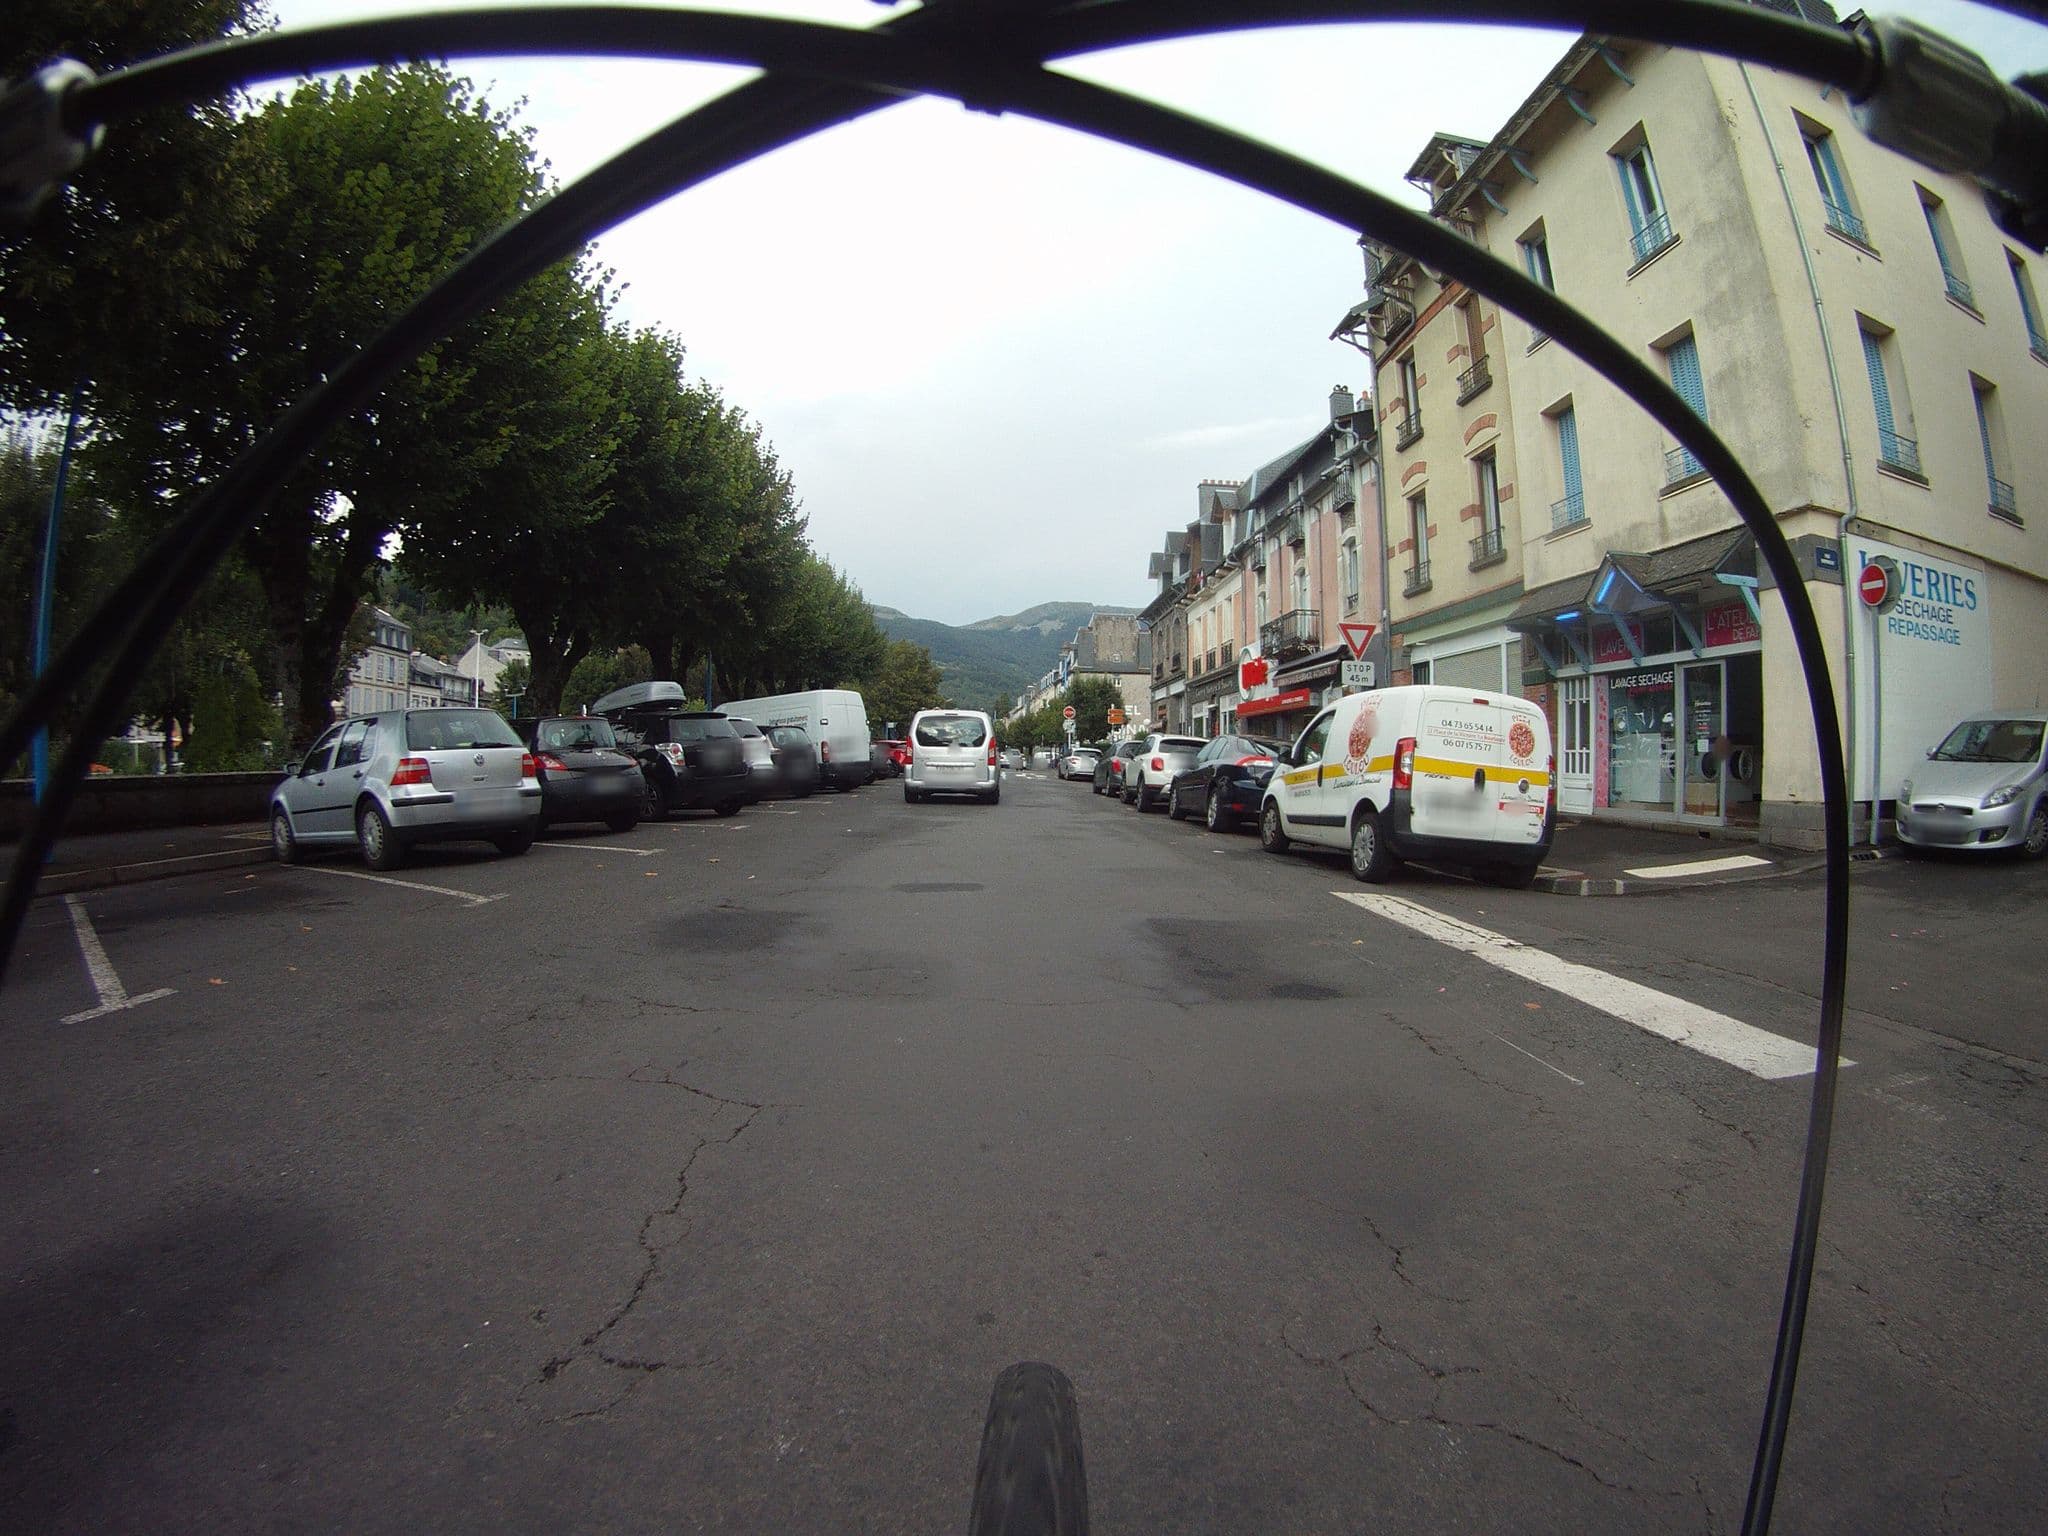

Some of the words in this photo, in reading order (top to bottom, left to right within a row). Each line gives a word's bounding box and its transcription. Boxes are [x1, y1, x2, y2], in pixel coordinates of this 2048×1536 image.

[1859, 550, 1977, 611] VERIES
[1895, 600, 1954, 624] SECHAGE
[1888, 617, 1961, 646] REPASSAGE
[1347, 664, 1371, 673] STOP
[1611, 675, 1637, 689] LAVAGE
[1638, 671, 1674, 686] SECHAGE
